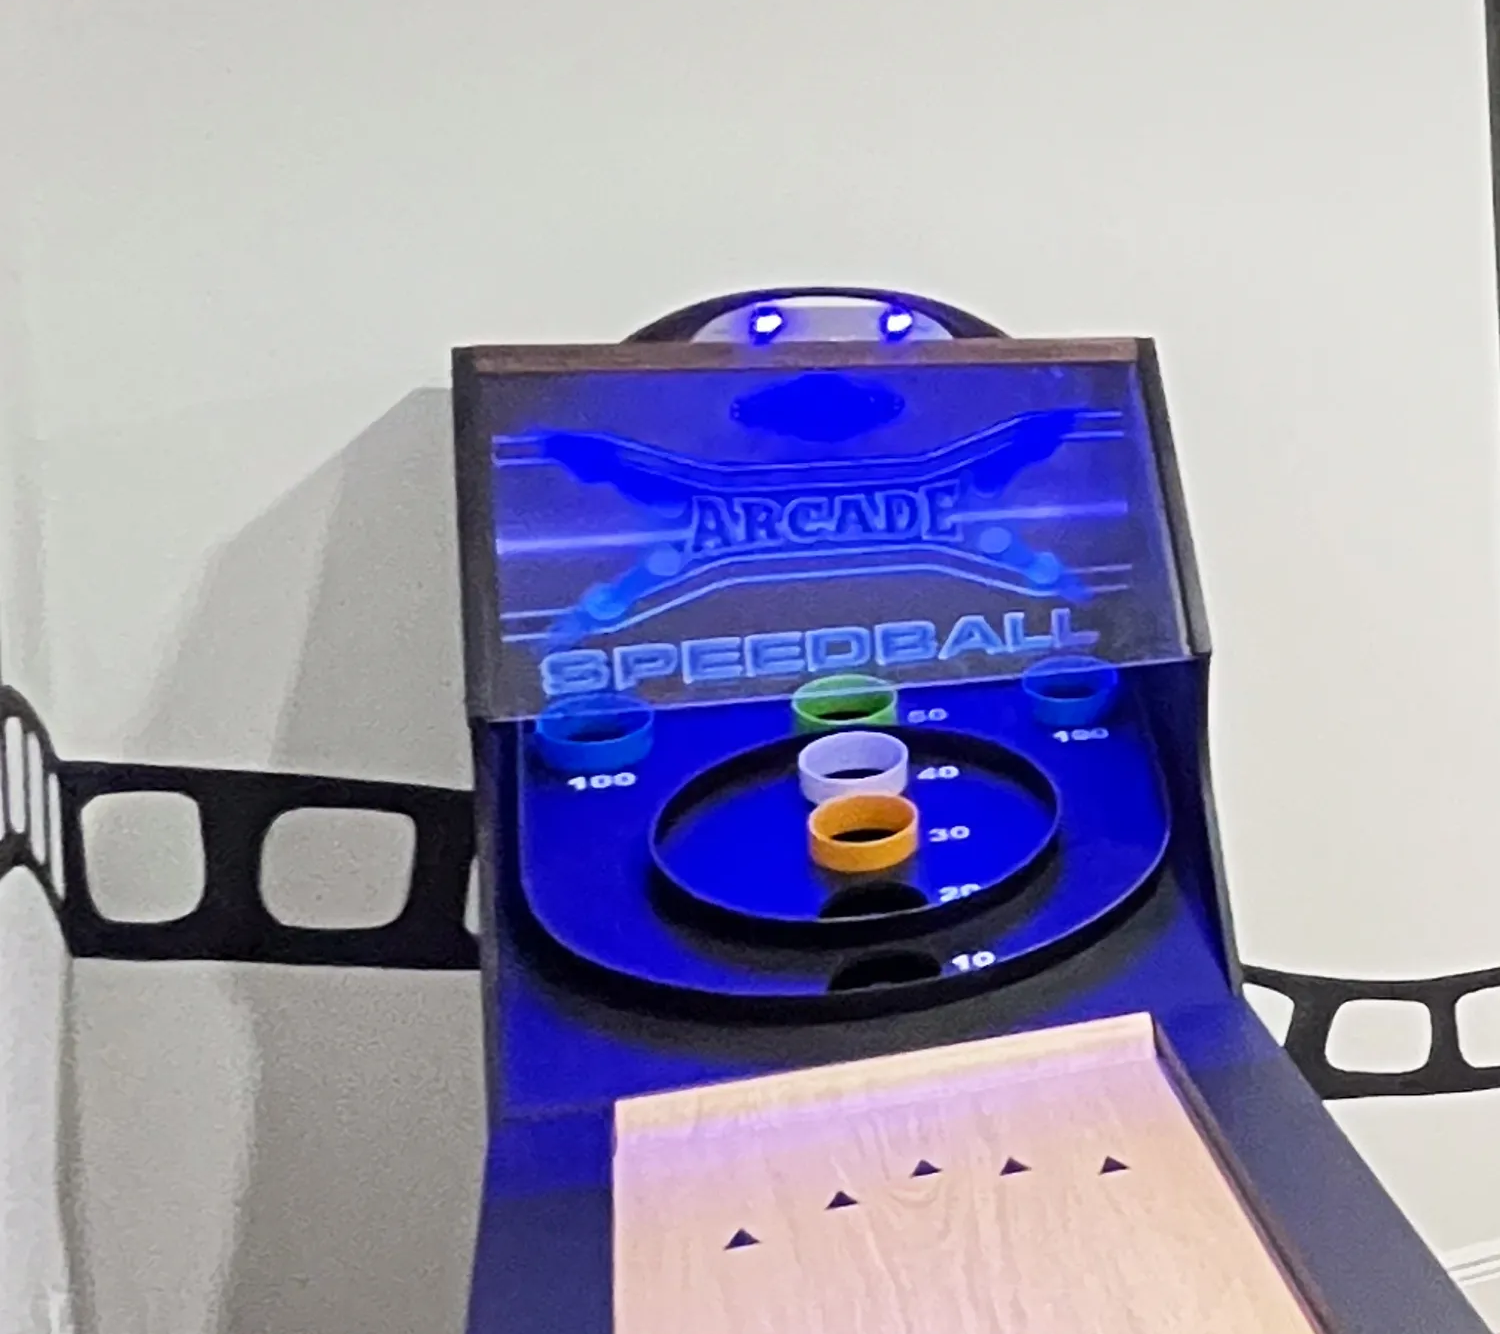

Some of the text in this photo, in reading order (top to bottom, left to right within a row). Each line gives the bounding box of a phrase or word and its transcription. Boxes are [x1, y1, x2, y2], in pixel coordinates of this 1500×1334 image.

[690, 479, 964, 559] ARCADE
[540, 608, 1099, 696] SPEEDBALL
[567, 771, 637, 791] 100
[916, 764, 960, 781] 40
[929, 825, 971, 843] 30
[950, 950, 996, 972] 10
